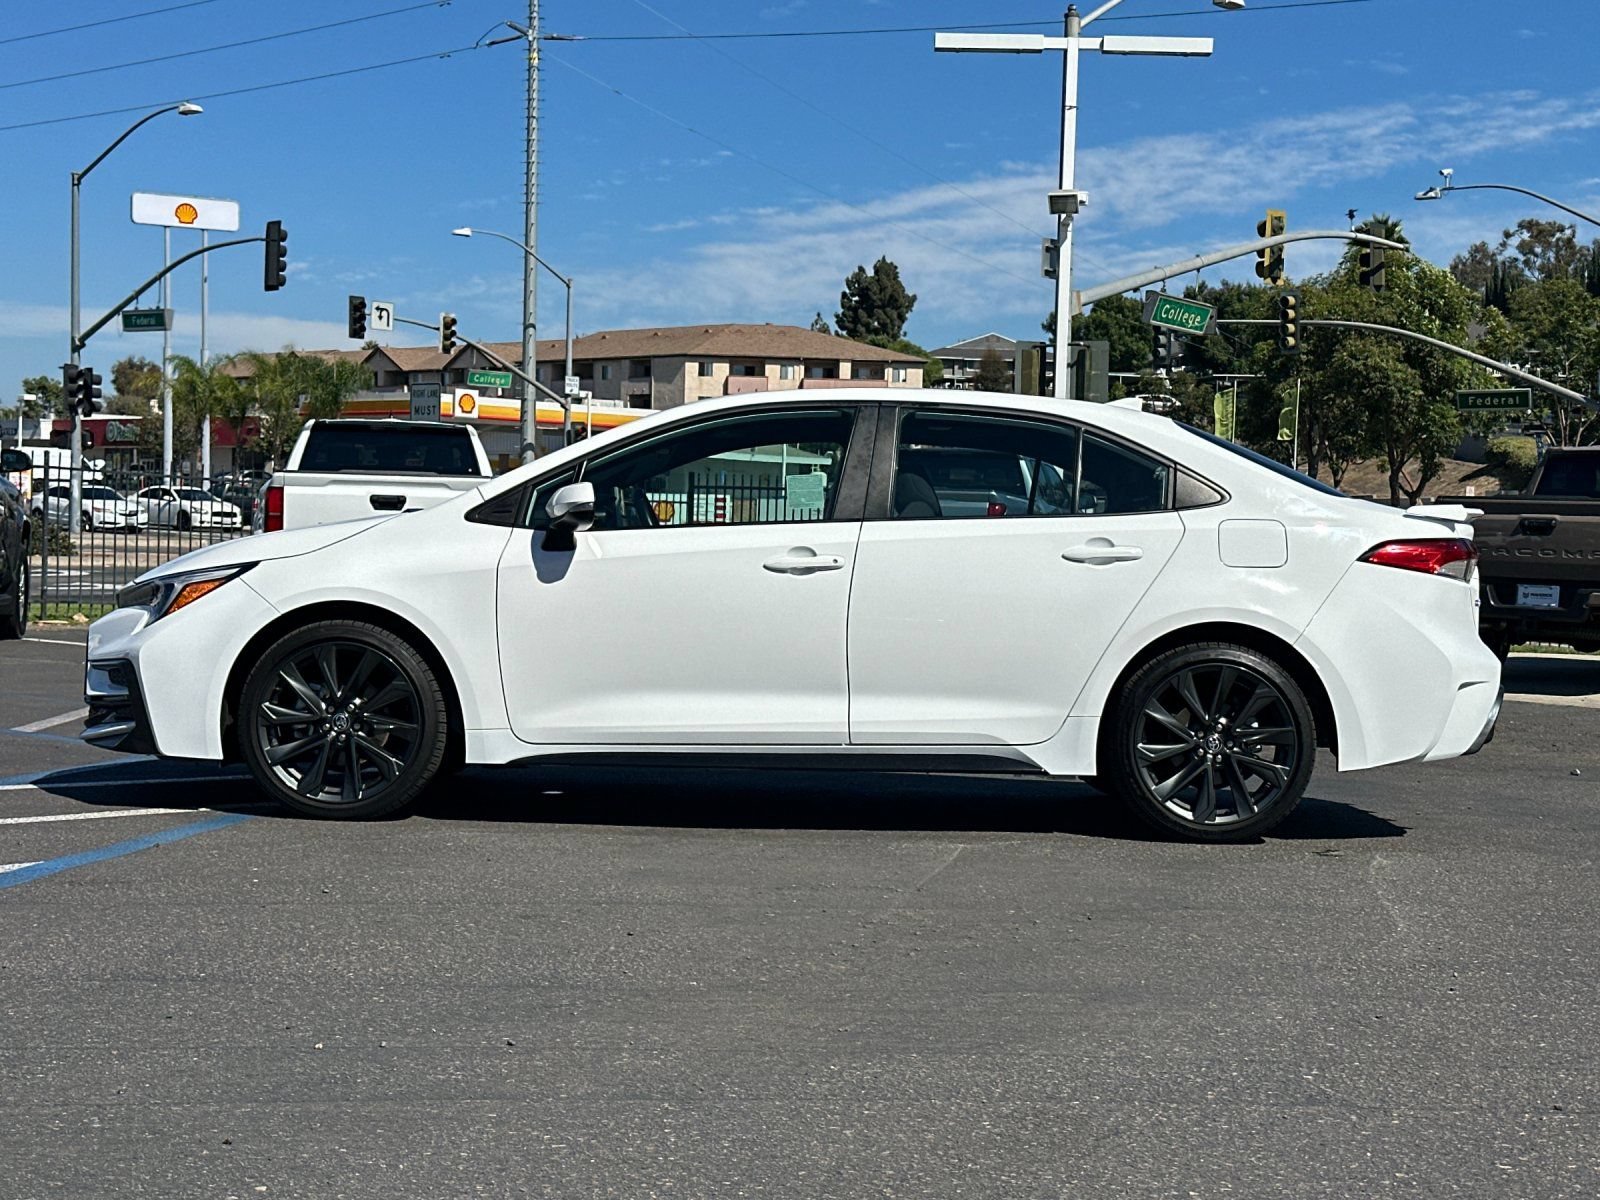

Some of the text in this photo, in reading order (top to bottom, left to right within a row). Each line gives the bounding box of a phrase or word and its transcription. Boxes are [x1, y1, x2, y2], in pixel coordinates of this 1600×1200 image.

[131, 315, 156, 326] Federal
[1161, 304, 1201, 328] College
[473, 374, 505, 386] College
[412, 388, 439, 399] RIGHT LANE
[1468, 396, 1519, 406] Federal
[413, 404, 437, 416] MUST
